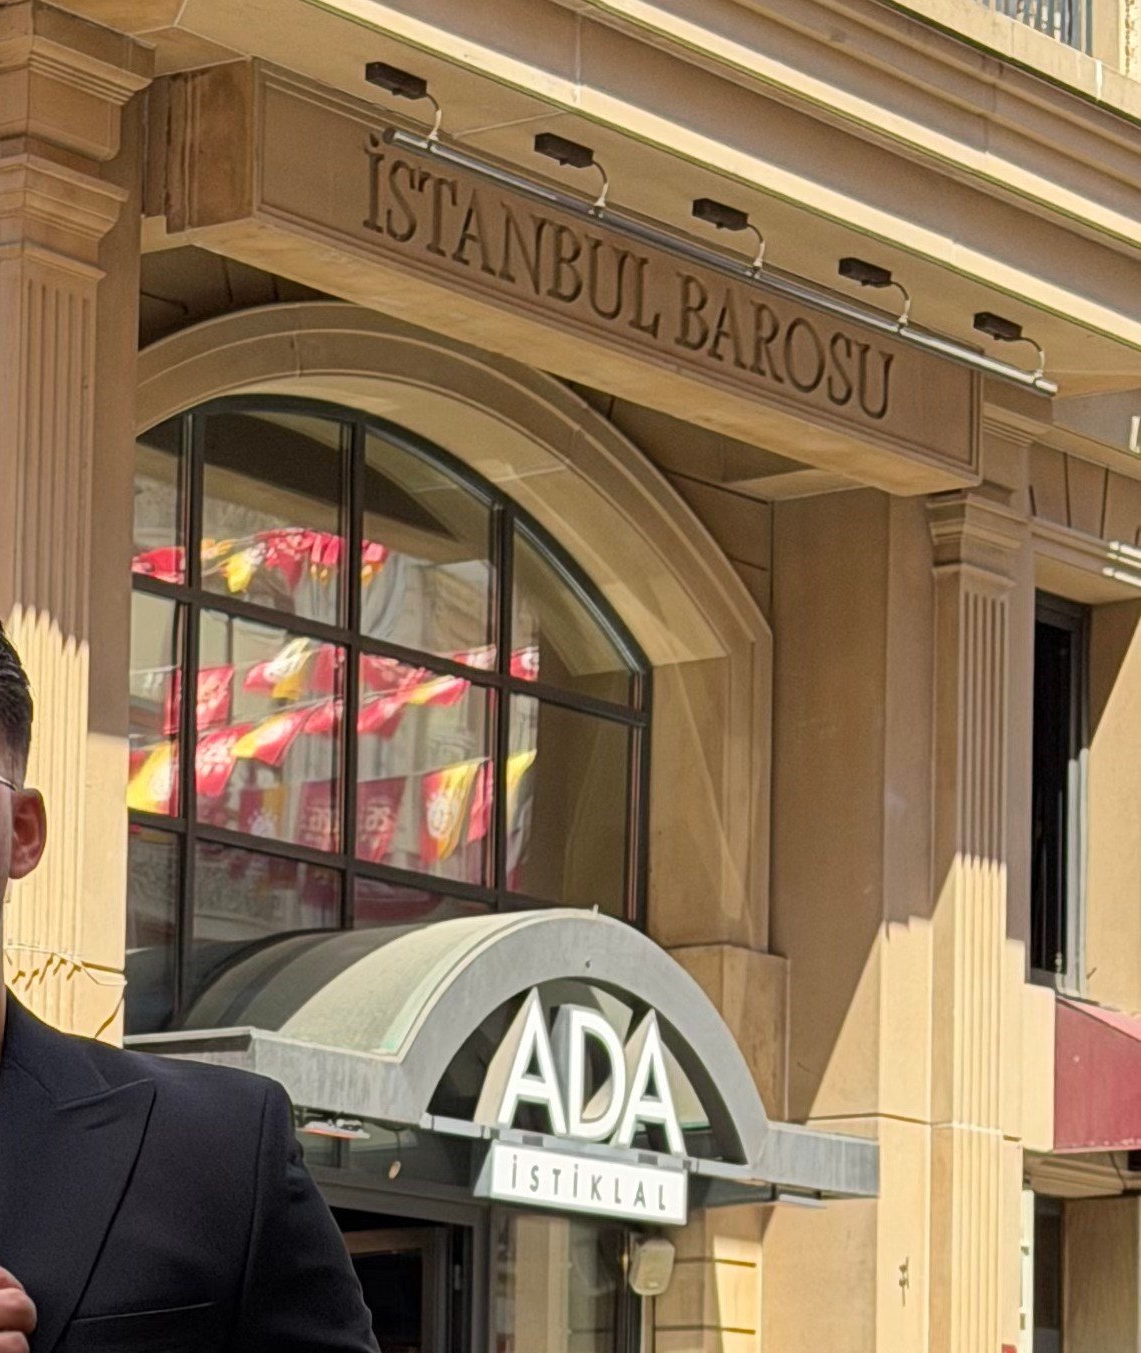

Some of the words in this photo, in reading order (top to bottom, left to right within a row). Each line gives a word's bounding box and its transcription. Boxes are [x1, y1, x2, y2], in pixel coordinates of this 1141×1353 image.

[362, 133, 661, 338] İSTANBUL
[675, 271, 894, 420] BAROSU
[496, 986, 687, 1157] ADA
[511, 1154, 667, 1211] İSTİKLAL
